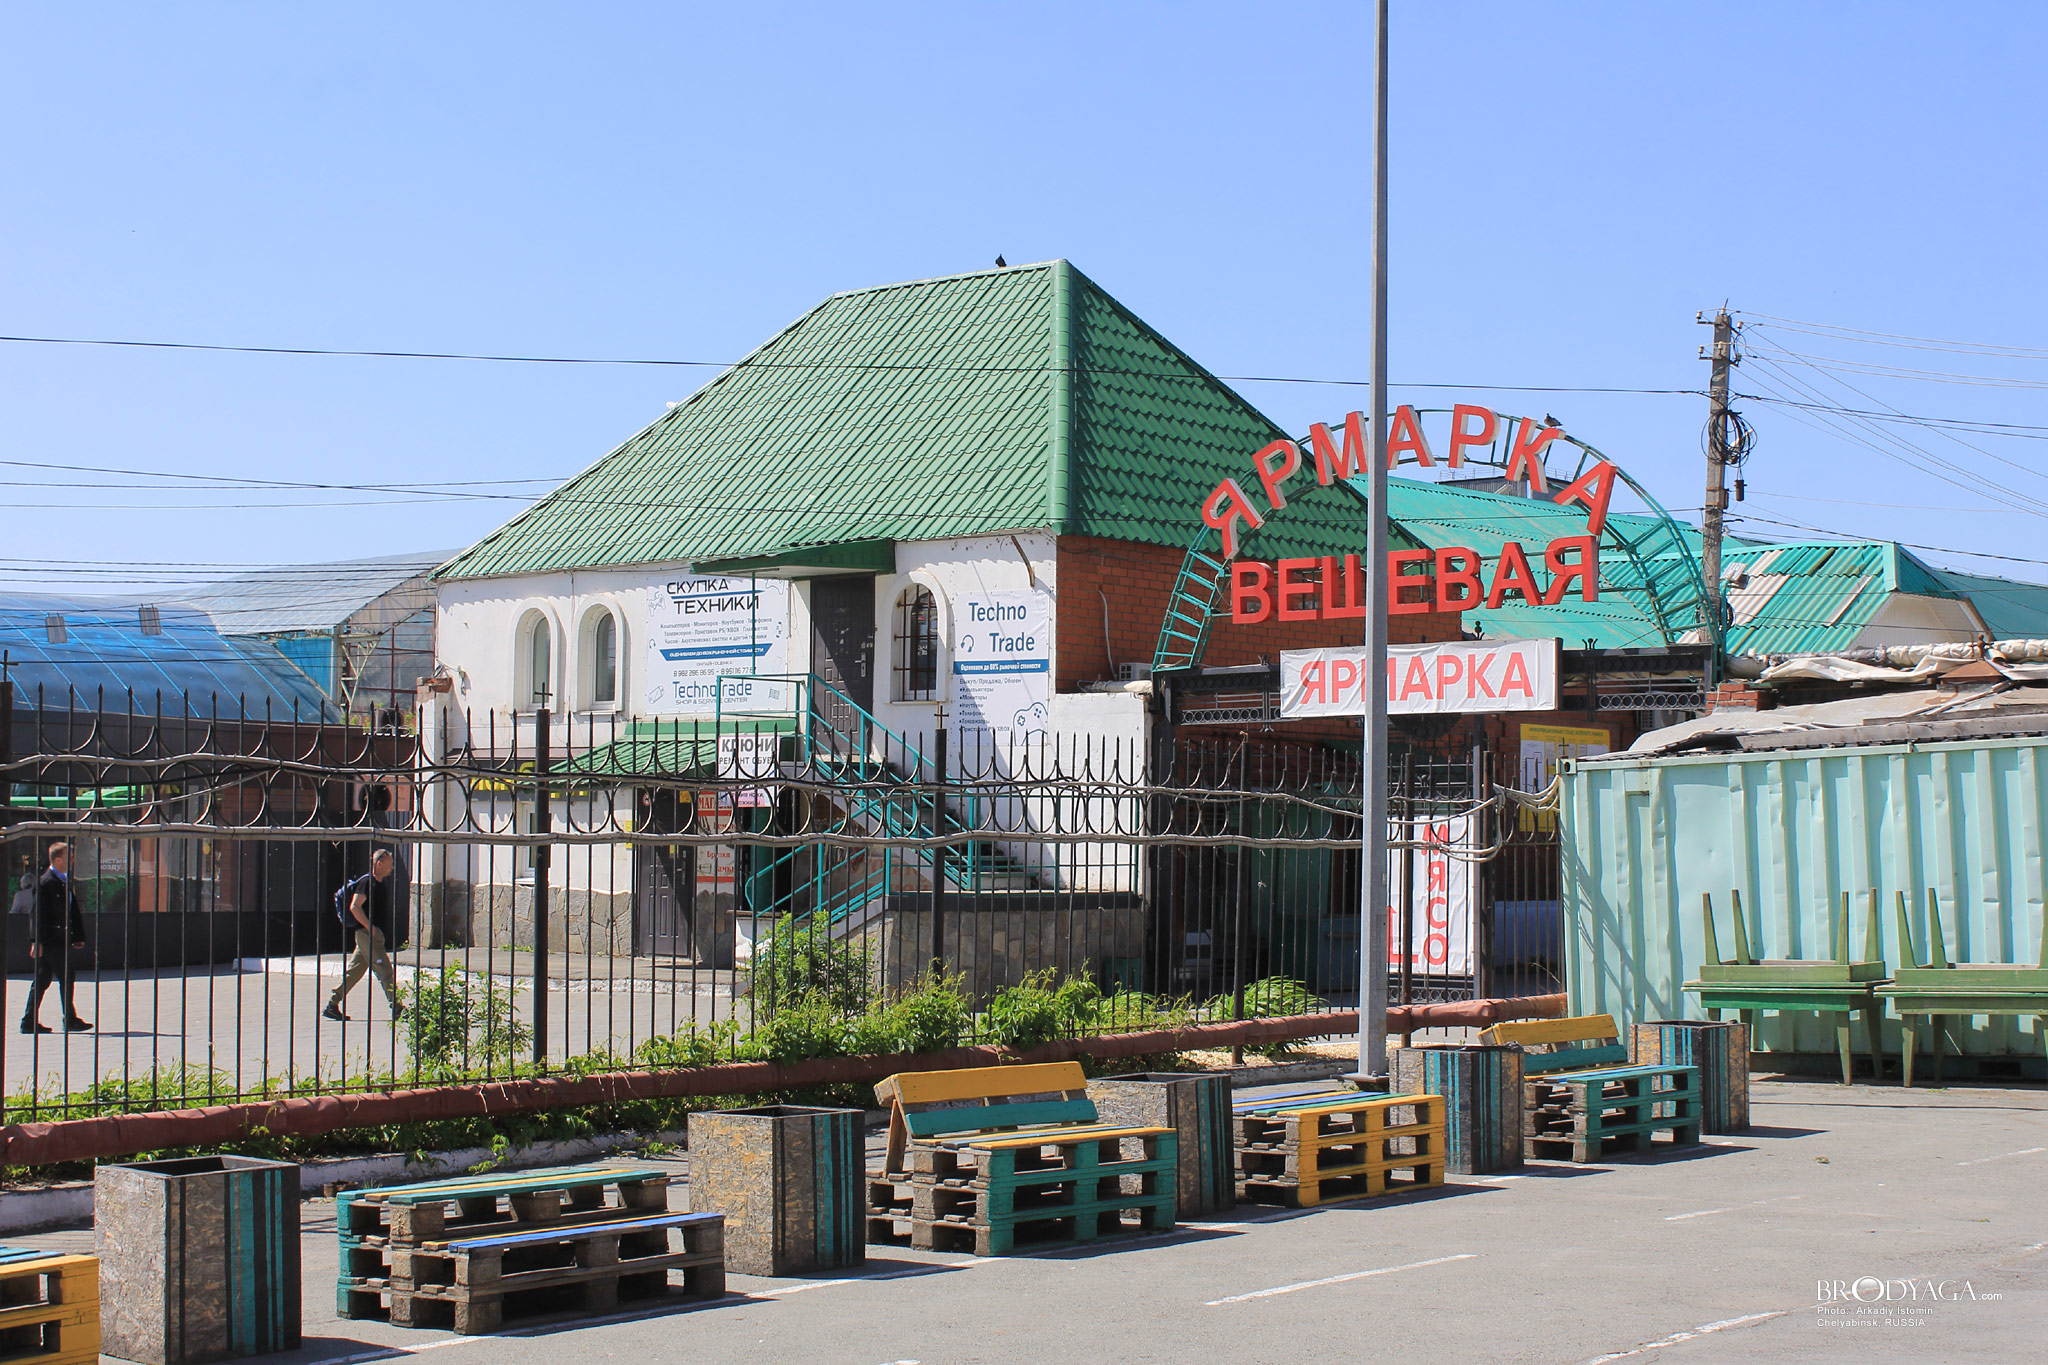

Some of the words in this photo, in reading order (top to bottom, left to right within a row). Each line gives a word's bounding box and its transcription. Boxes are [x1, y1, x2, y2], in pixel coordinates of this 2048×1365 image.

[1202, 404, 1618, 560] ЯРМАРКА
[667, 579, 729, 594] СКУПКА
[673, 595, 759, 614] ТЕХНИКИ
[968, 601, 1027, 621] Techno
[989, 632, 1035, 652] Trade
[1421, 824, 1448, 965] МЯСО
